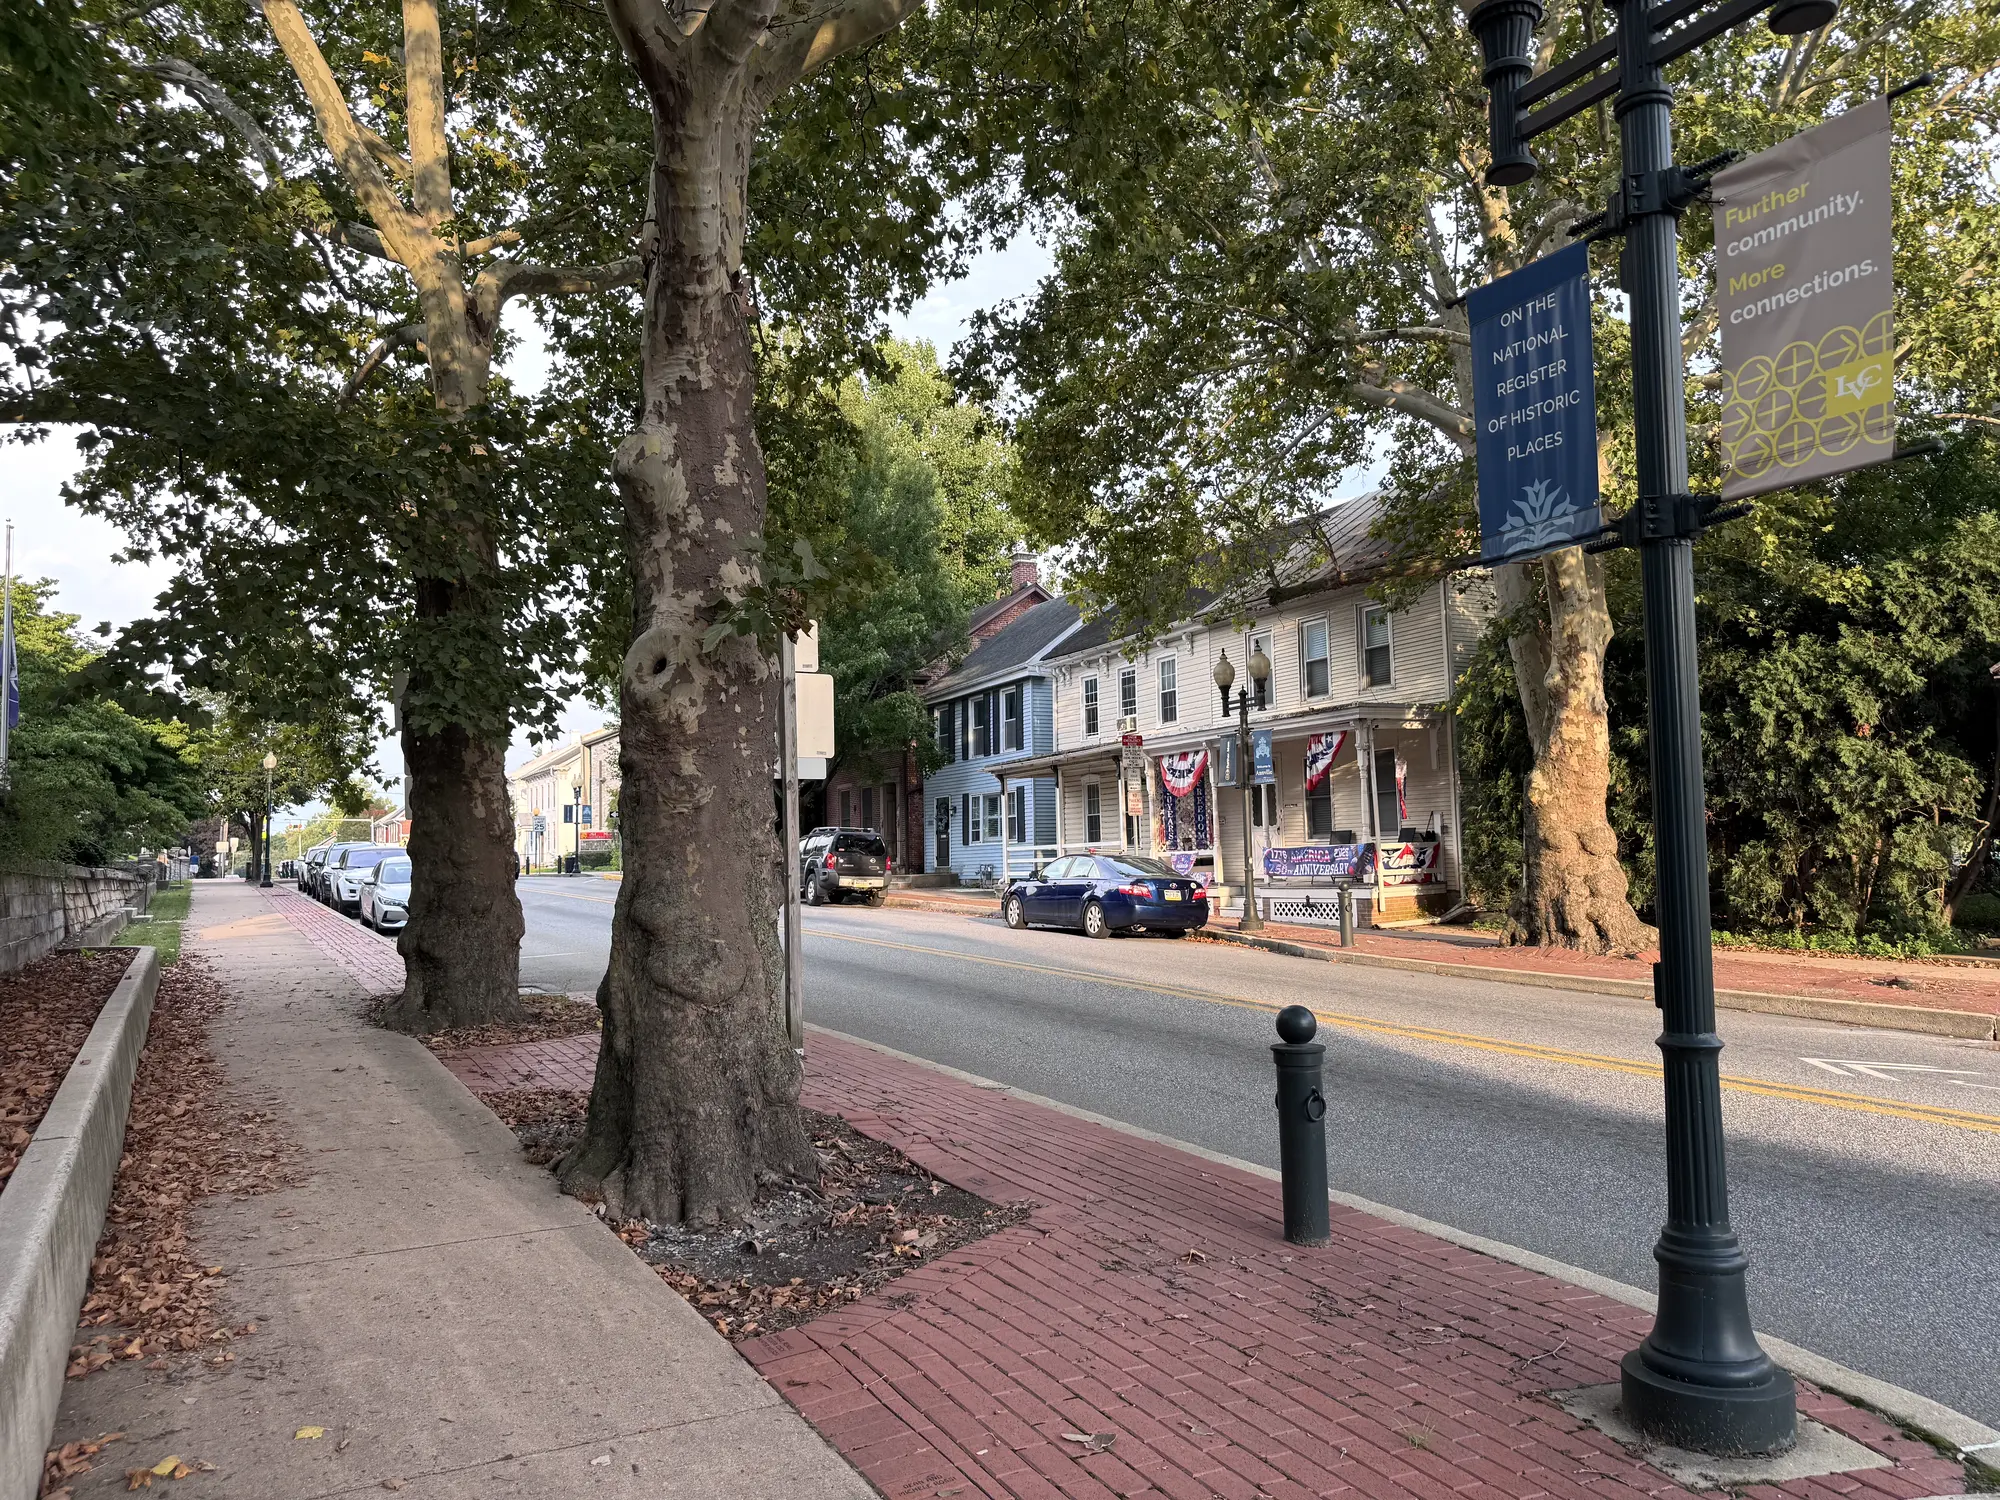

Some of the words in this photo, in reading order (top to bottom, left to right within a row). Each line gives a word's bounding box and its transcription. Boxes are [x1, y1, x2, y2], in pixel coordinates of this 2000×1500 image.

[1725, 181, 1810, 229] Further
[1726, 190, 1864, 257] community.
[1728, 263, 1786, 296] More
[1730, 259, 1879, 324] connections.
[1500, 310, 1523, 328] ON
[1525, 292, 1557, 317] THE
[1493, 324, 1569, 365] NATIONAL
[1497, 358, 1567, 397] REGISTER
[1487, 415, 1508, 433] OF
[1511, 389, 1580, 426] HISTORIC
[1507, 431, 1563, 461] PLACES
[1270, 849, 1288, 859] 1776
[1290, 849, 1331, 863] AMERICA
[1293, 862, 1349, 875] ANNIVERSARY
